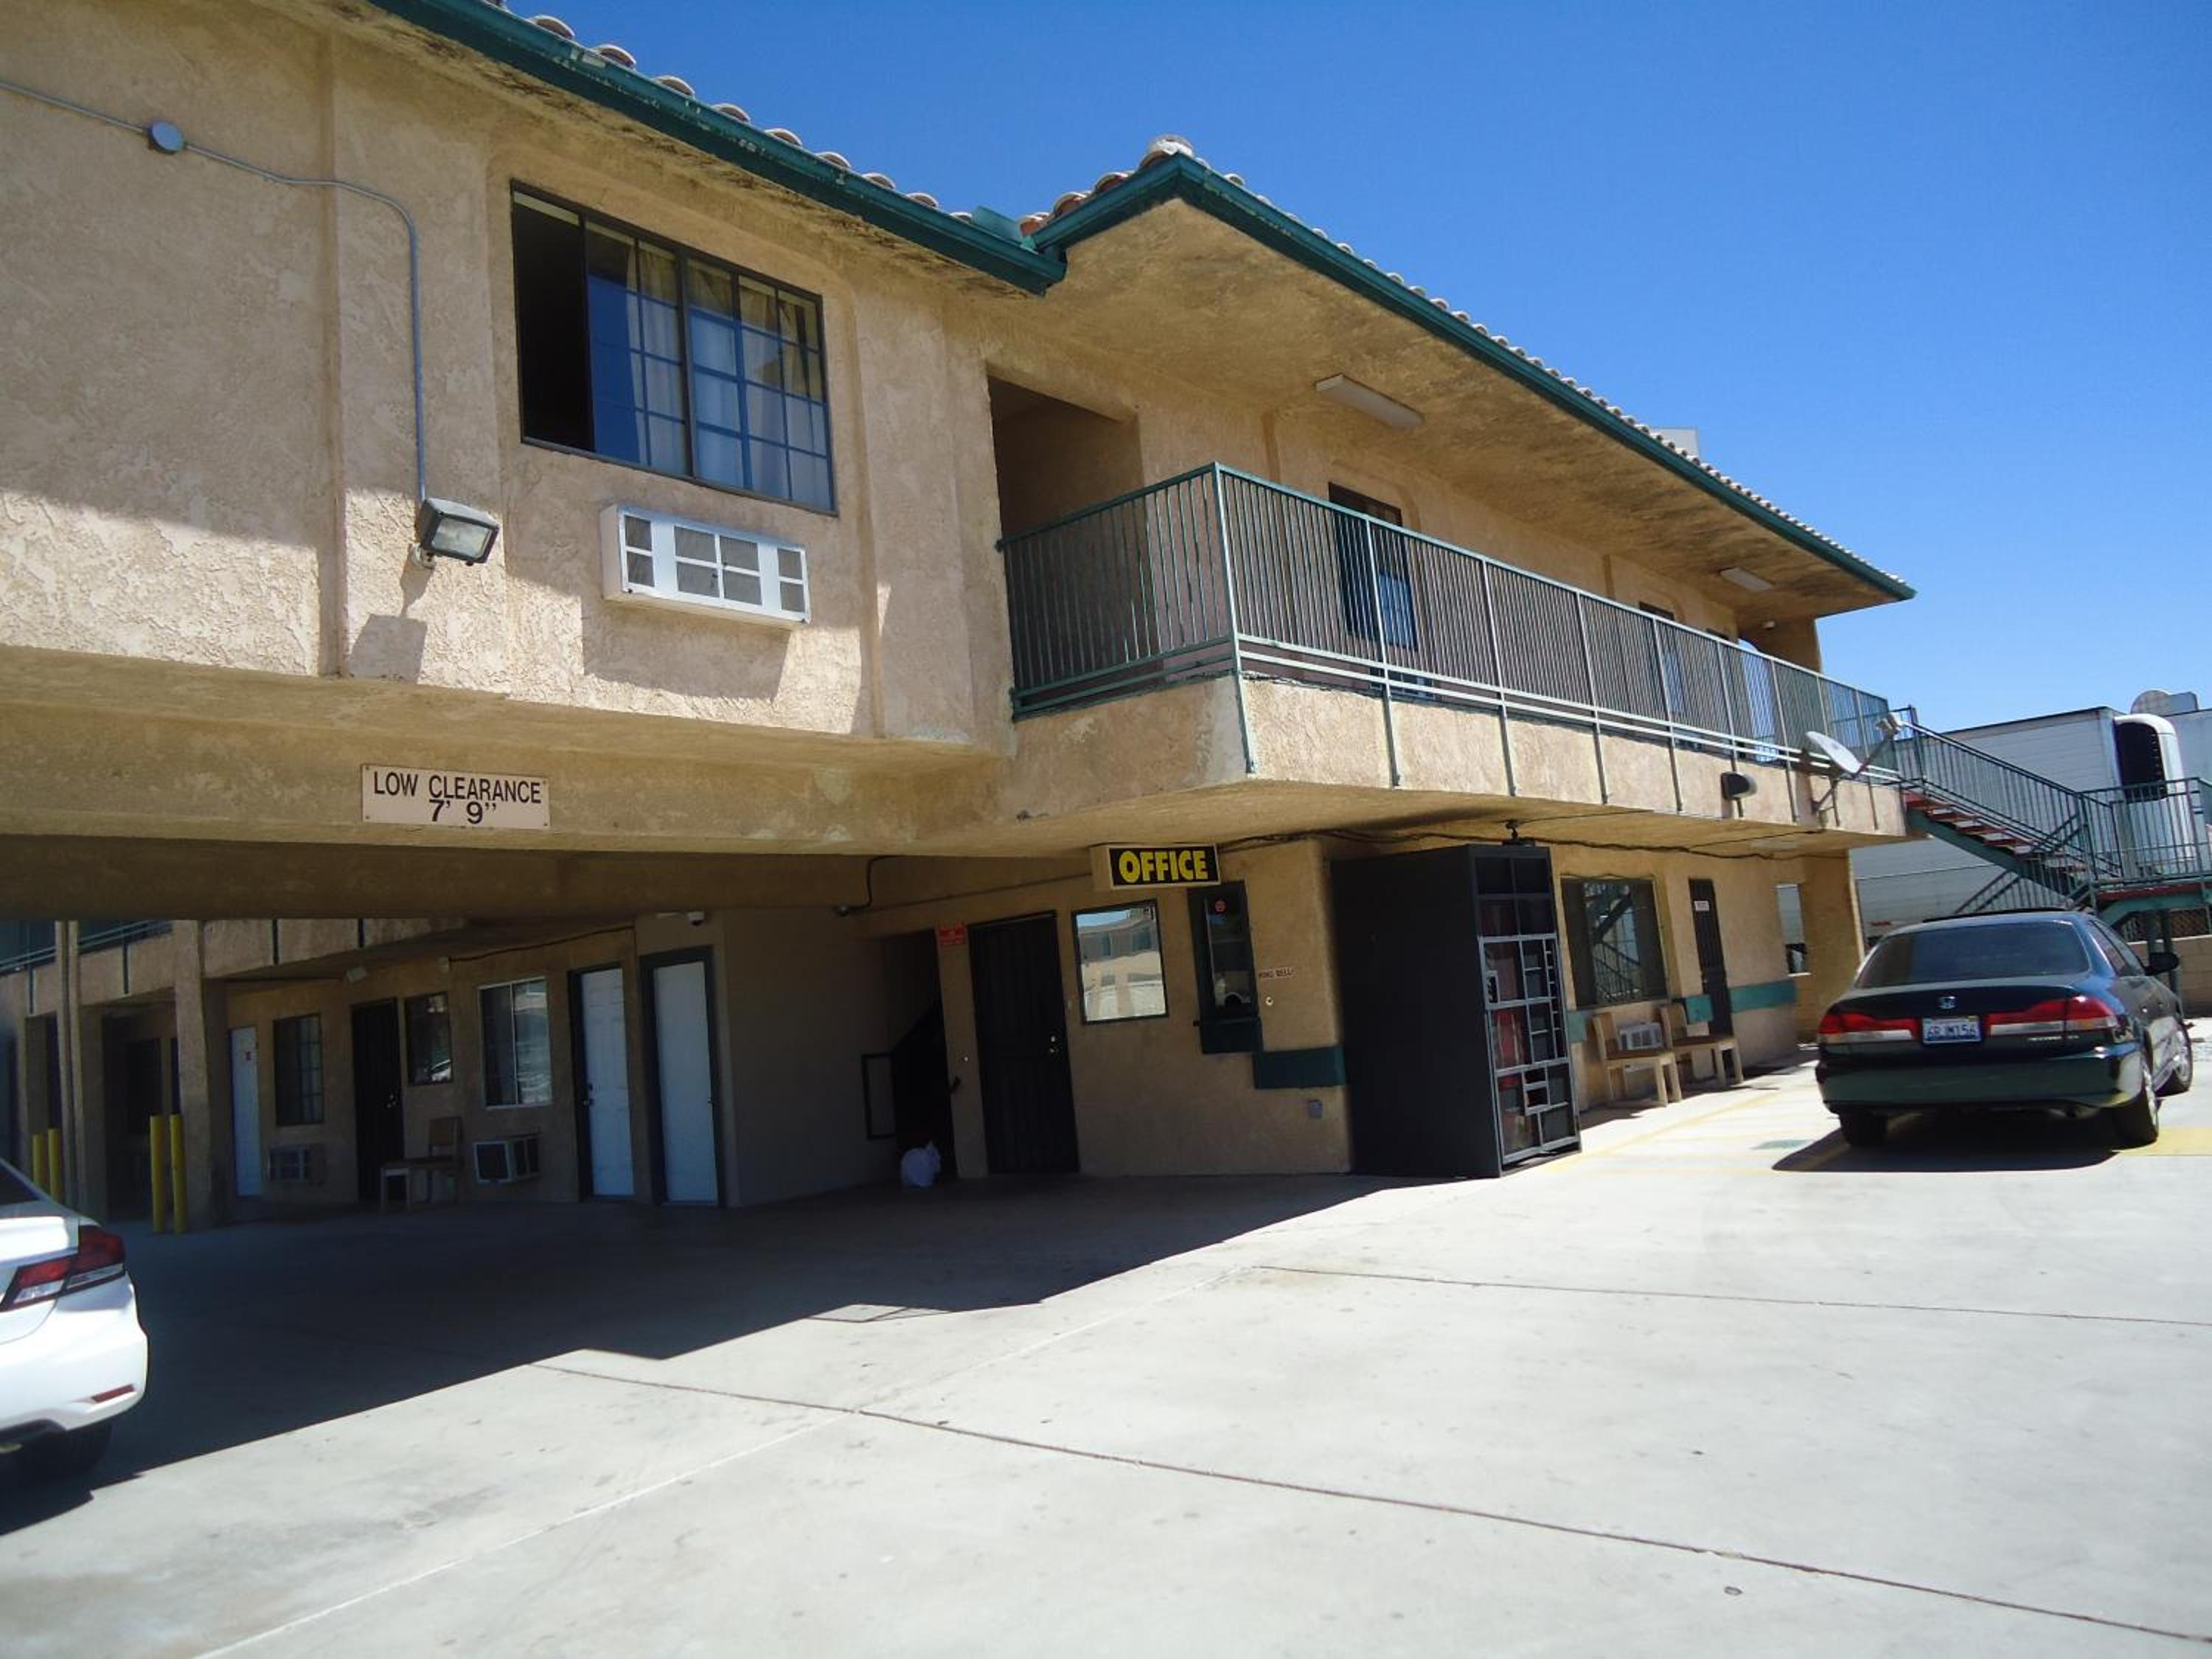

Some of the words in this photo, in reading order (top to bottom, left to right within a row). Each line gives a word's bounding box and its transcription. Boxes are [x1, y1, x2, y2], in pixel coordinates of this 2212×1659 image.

[373, 771, 419, 797] LOW
[428, 774, 542, 804] CLEARANCE
[1119, 851, 1208, 883] OFFICE
